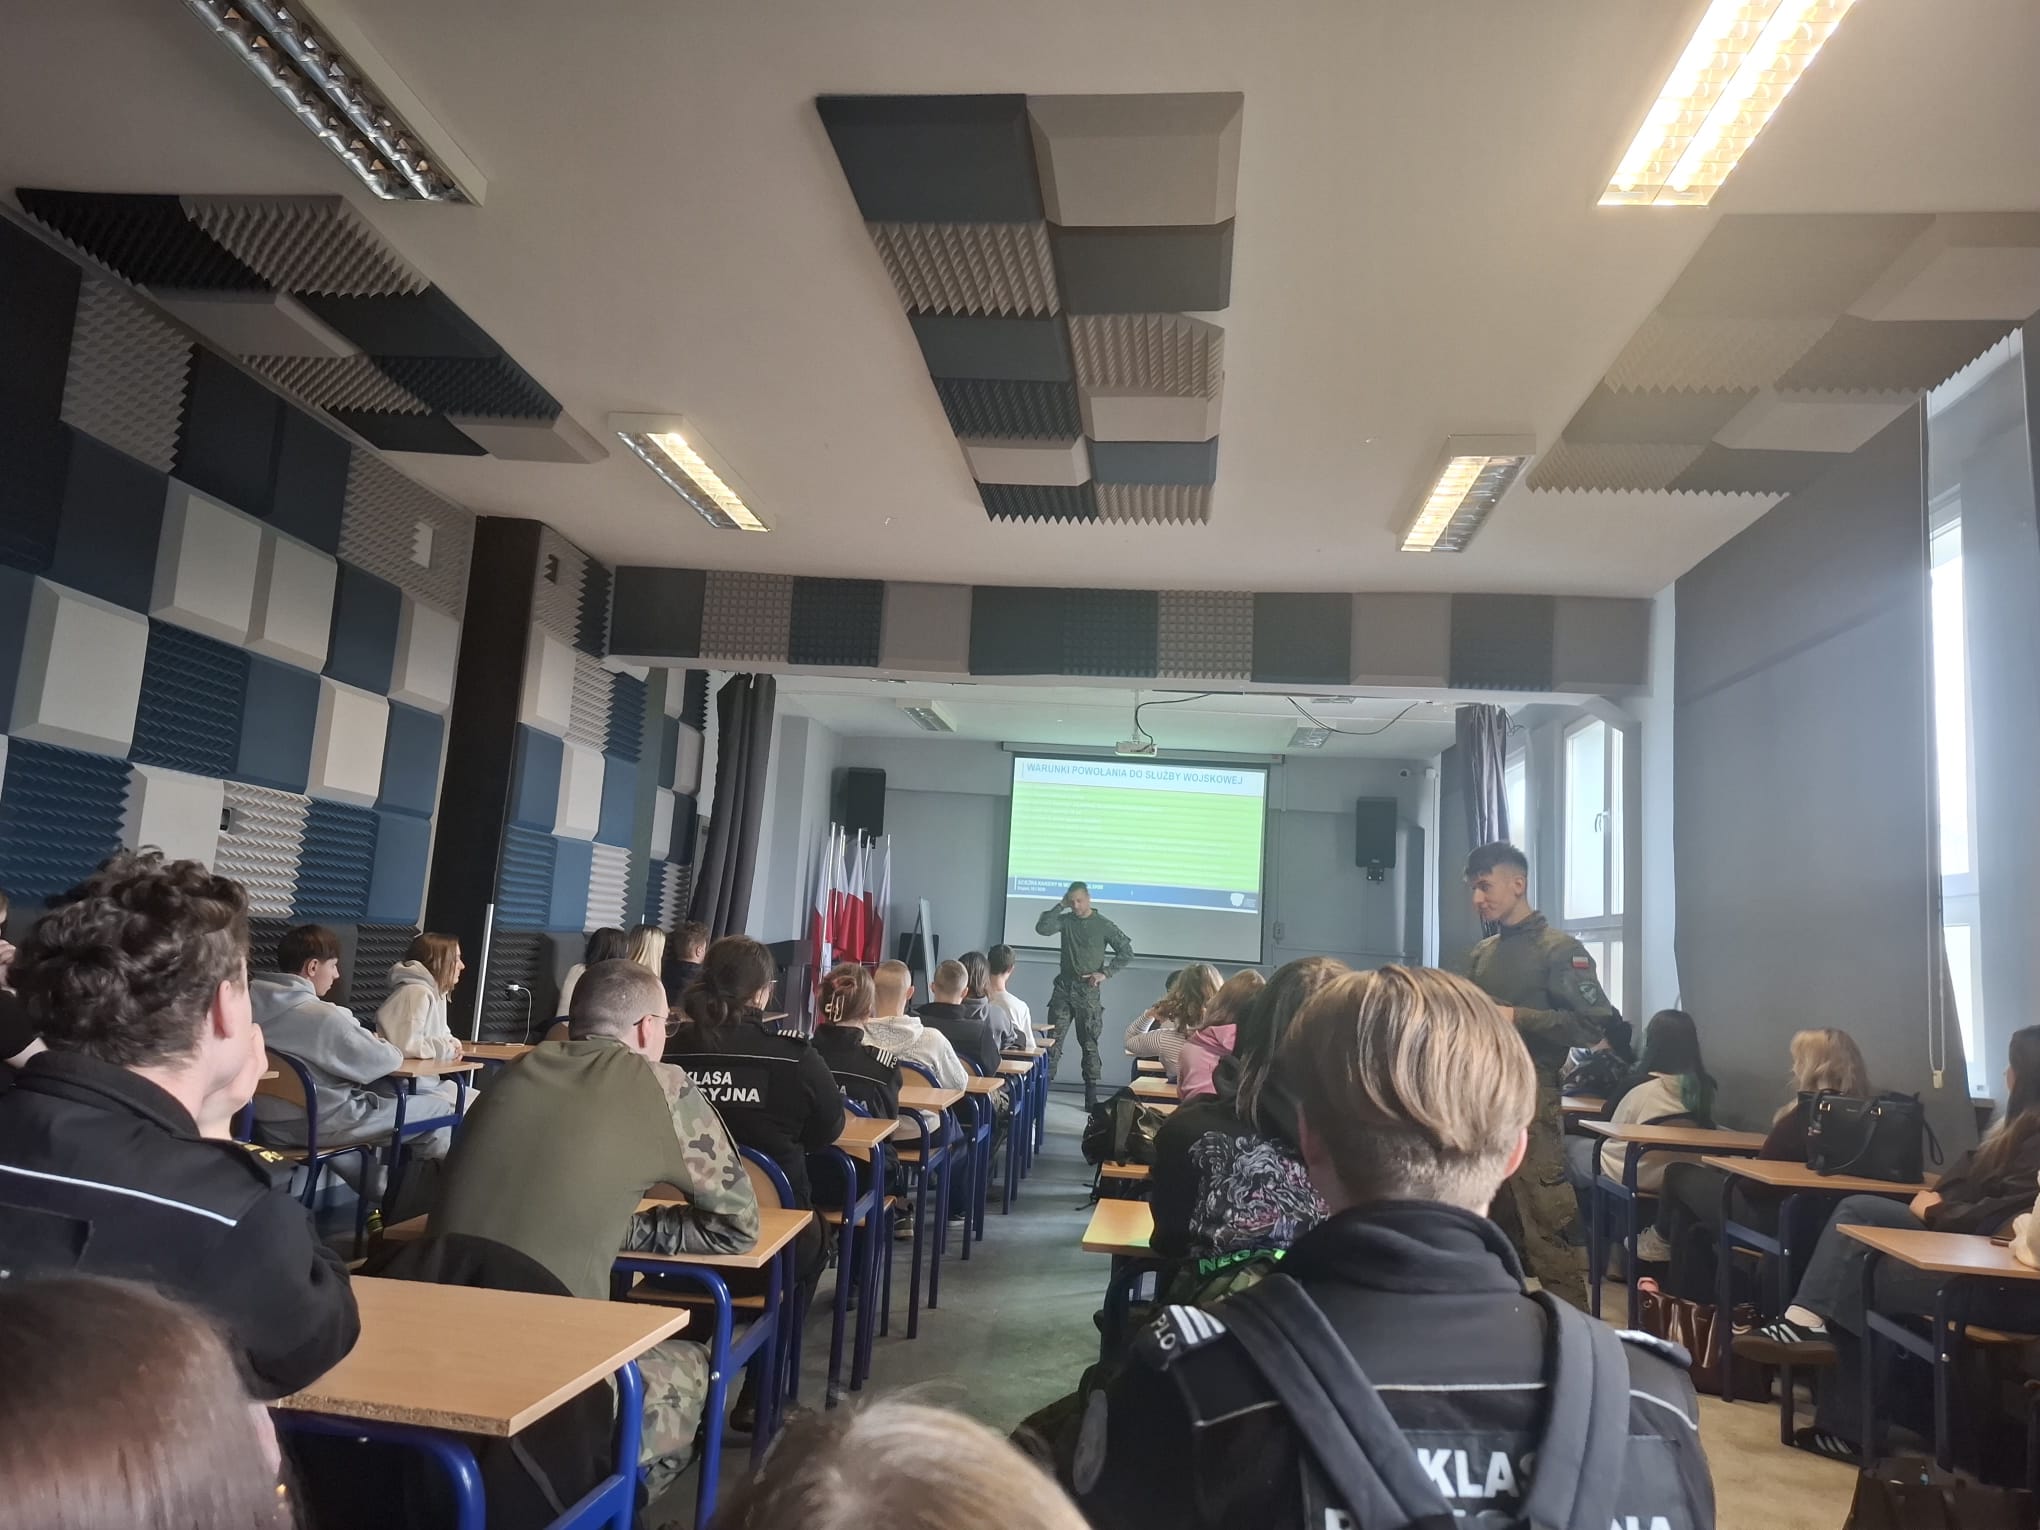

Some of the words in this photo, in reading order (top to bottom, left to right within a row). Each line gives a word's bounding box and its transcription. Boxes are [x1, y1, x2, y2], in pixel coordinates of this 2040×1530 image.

[1027, 763, 1070, 775] WARUNKI
[1129, 769, 1143, 778] DO
[1183, 773, 1243, 785] WOJSKOWEJ
[700, 1087, 760, 1103] YJNA
